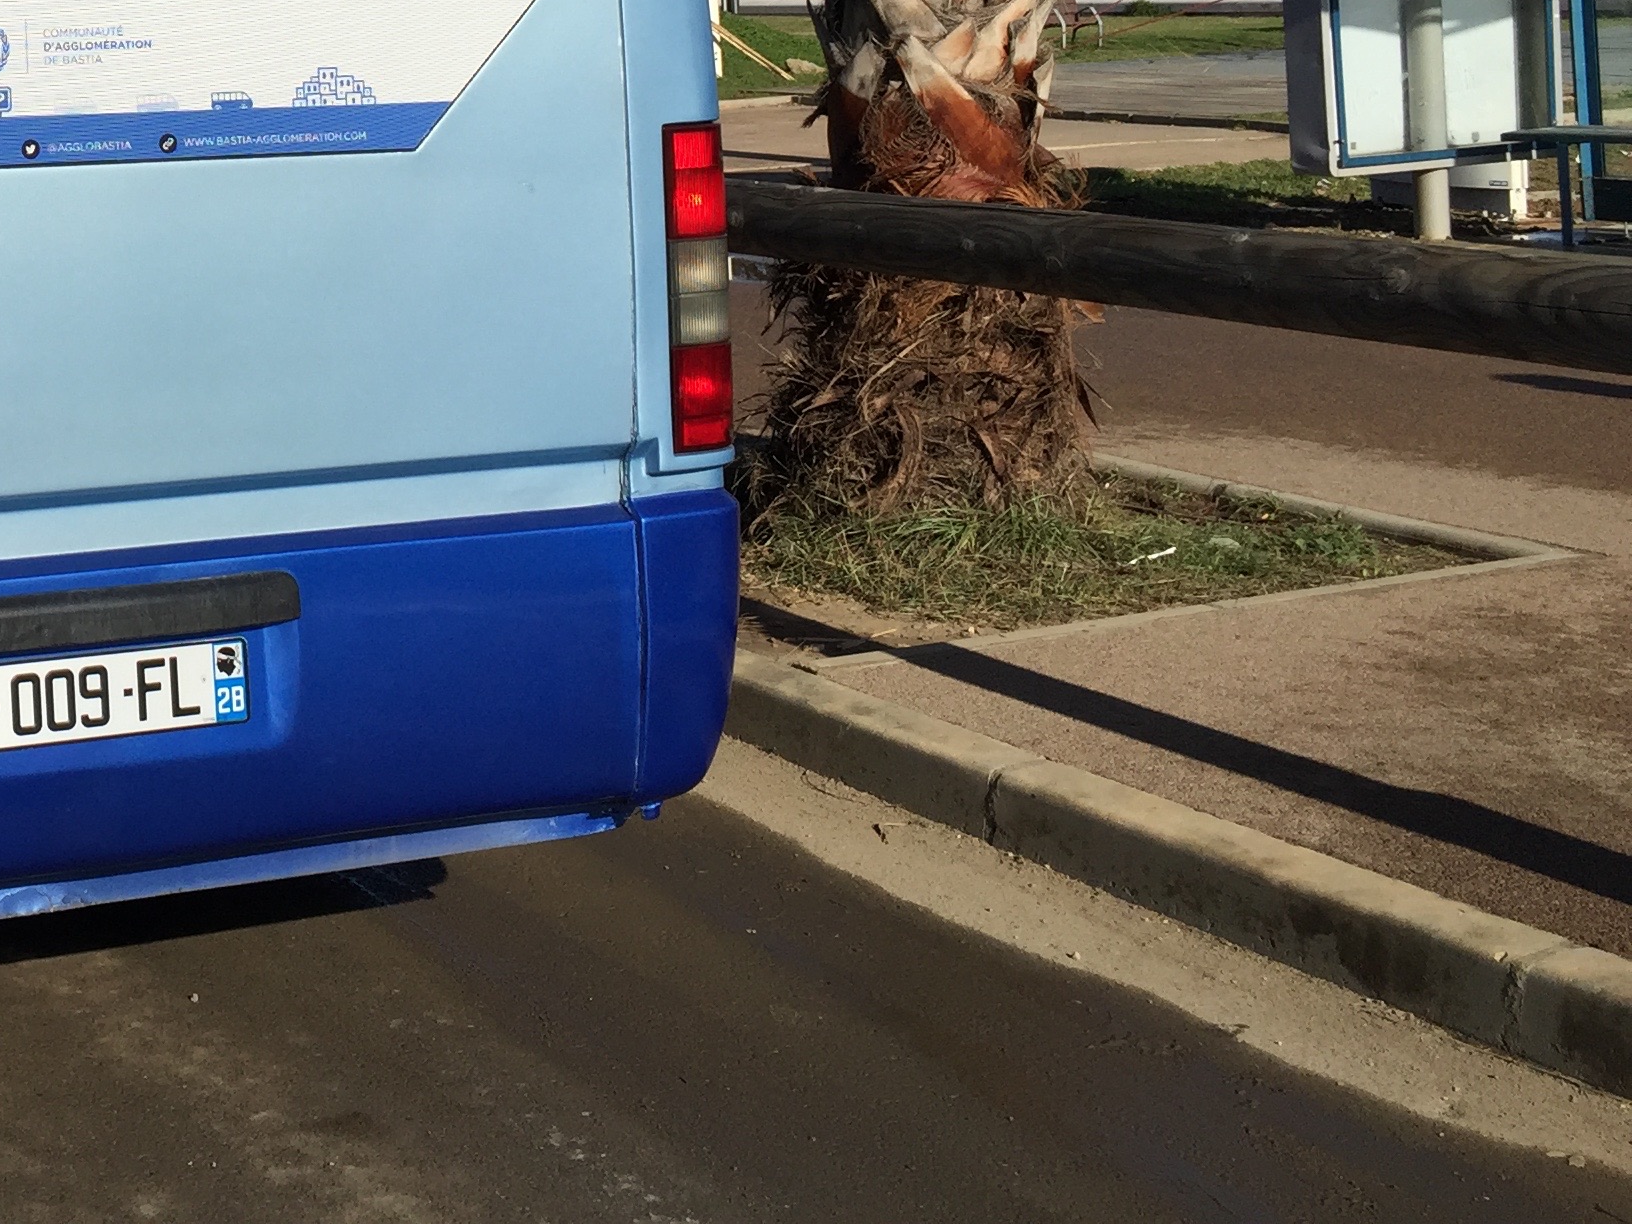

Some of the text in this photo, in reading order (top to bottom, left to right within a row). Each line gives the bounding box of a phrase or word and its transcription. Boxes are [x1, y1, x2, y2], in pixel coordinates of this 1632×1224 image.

[43, 26, 124, 38] COMMUNAUTÉ
[43, 40, 152, 52] D'AGGLOMÉRATION
[44, 54, 104, 65] DE BASTIA
[47, 140, 132, 154] @AGGLOBASTIA
[217, 687, 245, 714] 2B
